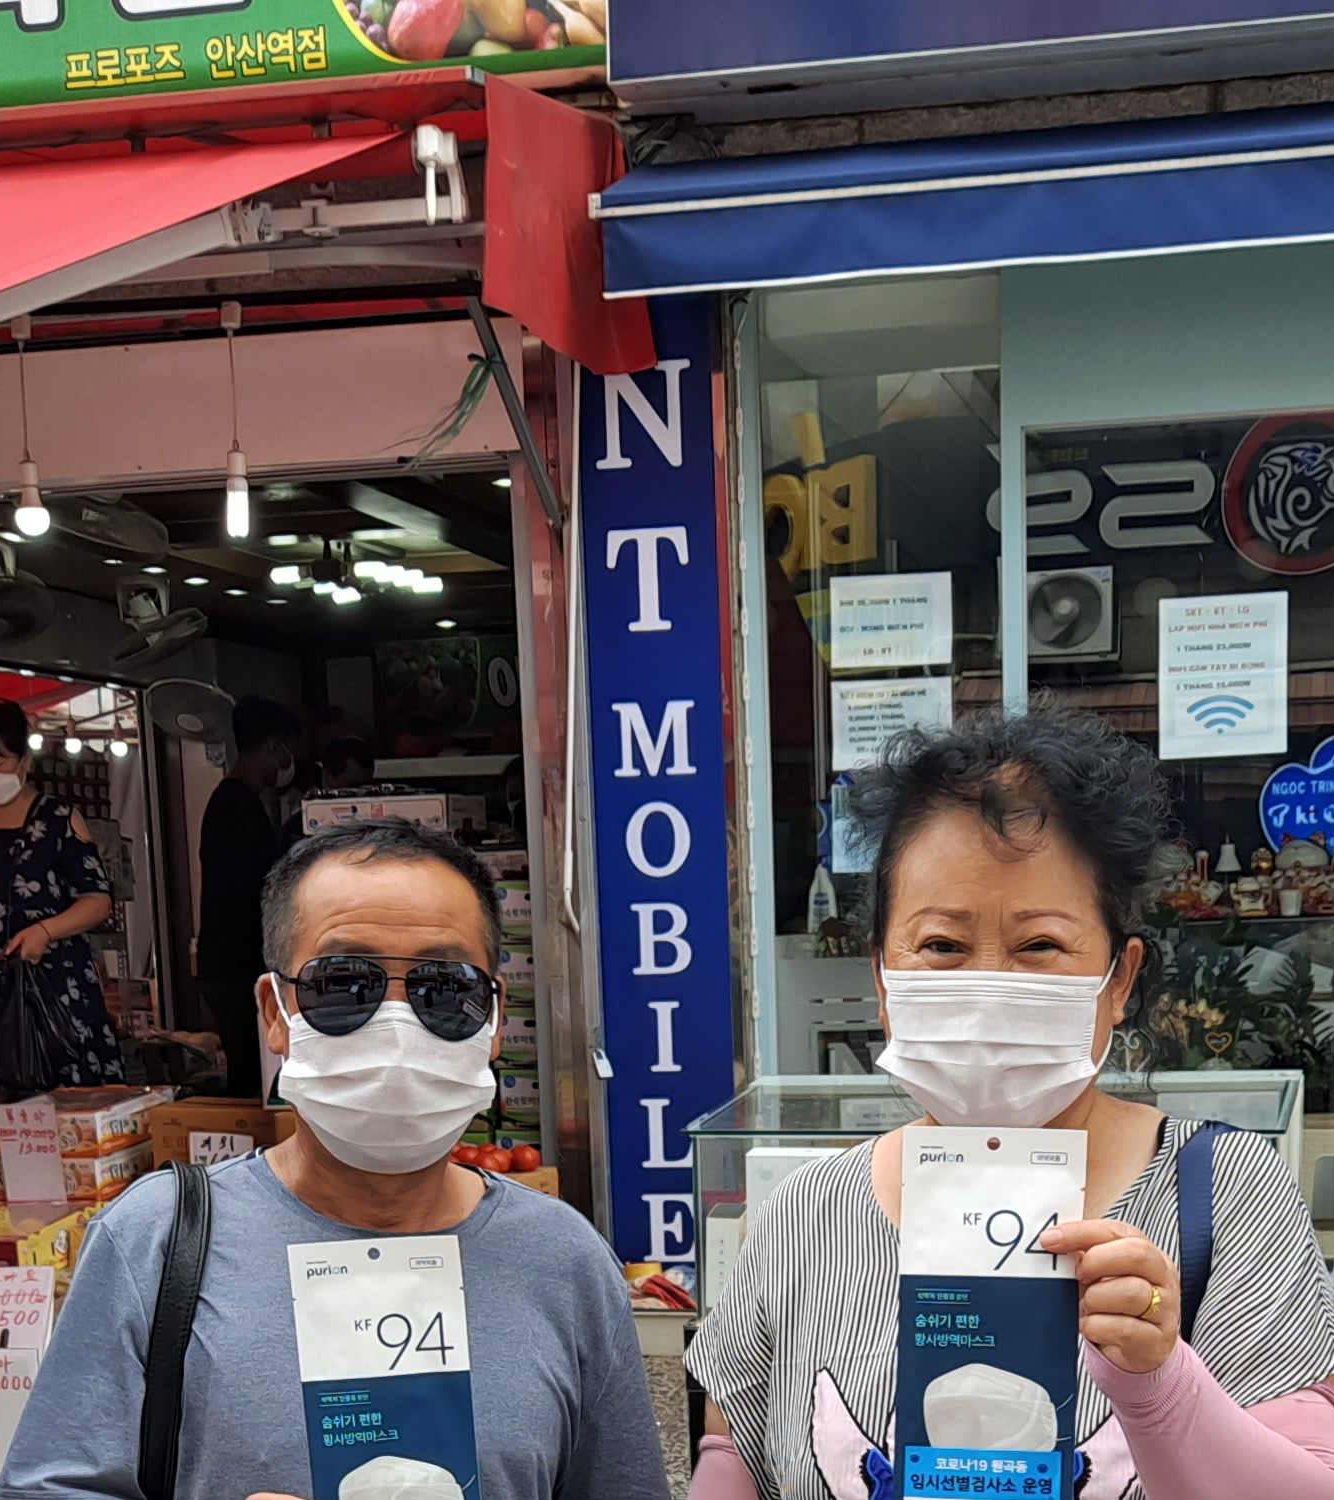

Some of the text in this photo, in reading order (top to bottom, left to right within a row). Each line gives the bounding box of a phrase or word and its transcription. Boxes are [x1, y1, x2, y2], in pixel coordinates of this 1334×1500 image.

[65, 25, 328, 90] 프로포즈 안산역점
[915, 1313, 980, 1329] 숨쉬기 편한
[321, 1412, 382, 1430] 숨쉬기 편한
[935, 1458, 1028, 1473] 코로나19 원곡동
[910, 1473, 1053, 1495] 임시선별검사소 운영
